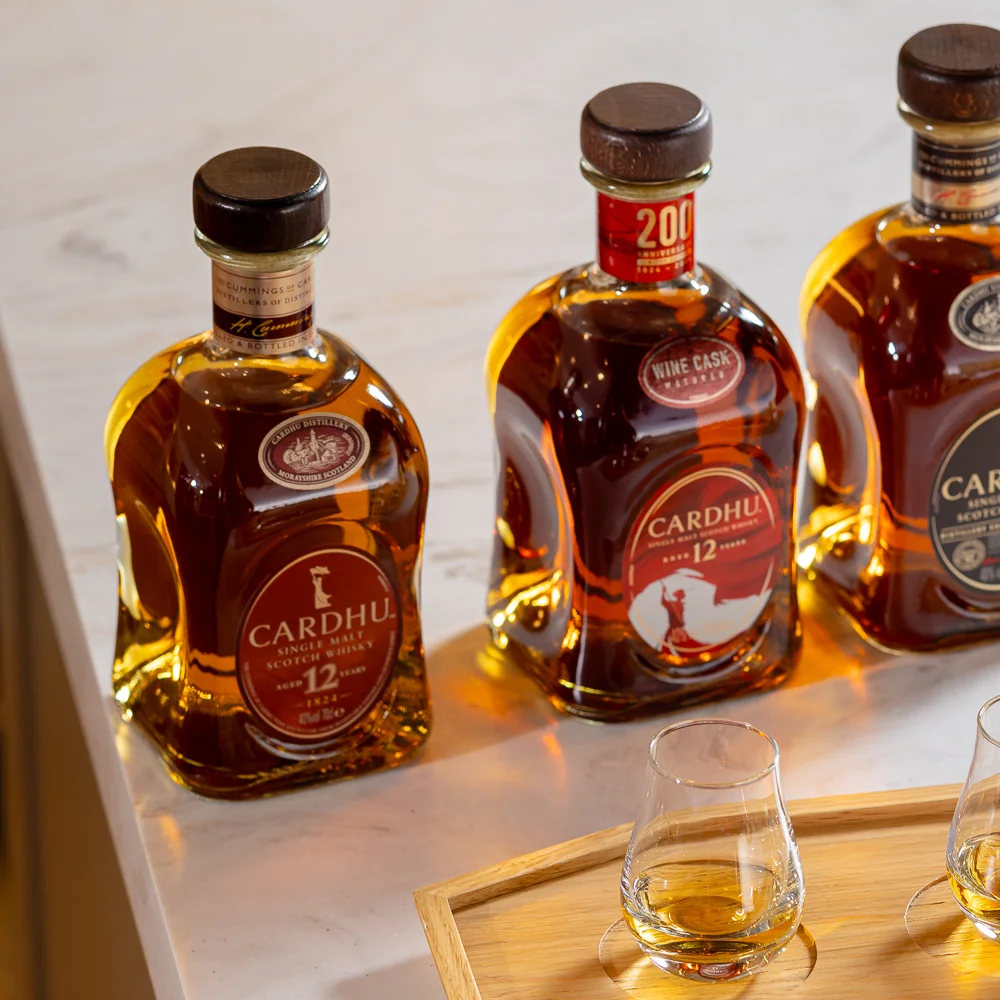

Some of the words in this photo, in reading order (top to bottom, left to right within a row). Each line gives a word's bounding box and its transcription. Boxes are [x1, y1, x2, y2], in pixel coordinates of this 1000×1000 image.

[636, 199, 692, 248] 200
[226, 281, 284, 295] CUMMINGS
[248, 339, 295, 350] BOTTLED
[652, 358, 690, 380] WINE
[693, 350, 730, 371] CASK
[271, 422, 300, 445] CARDHU
[303, 419, 350, 431] DISTILLERY
[278, 469, 323, 482] MORAYSHIRE
[323, 455, 357, 480] SCOTLAND
[648, 494, 760, 538] CARDHU
[693, 538, 717, 564] 12
[249, 597, 390, 648] CARDHU
[266, 652, 320, 670] SCOTCH
[325, 640, 374, 658] WHISKY
[277, 640, 323, 657] SINGLE
[330, 631, 364, 645] MALT
[276, 679, 303, 690] AGED
[302, 663, 339, 695] 12
[340, 665, 366, 678] YEARS
[306, 694, 338, 708] 1824
